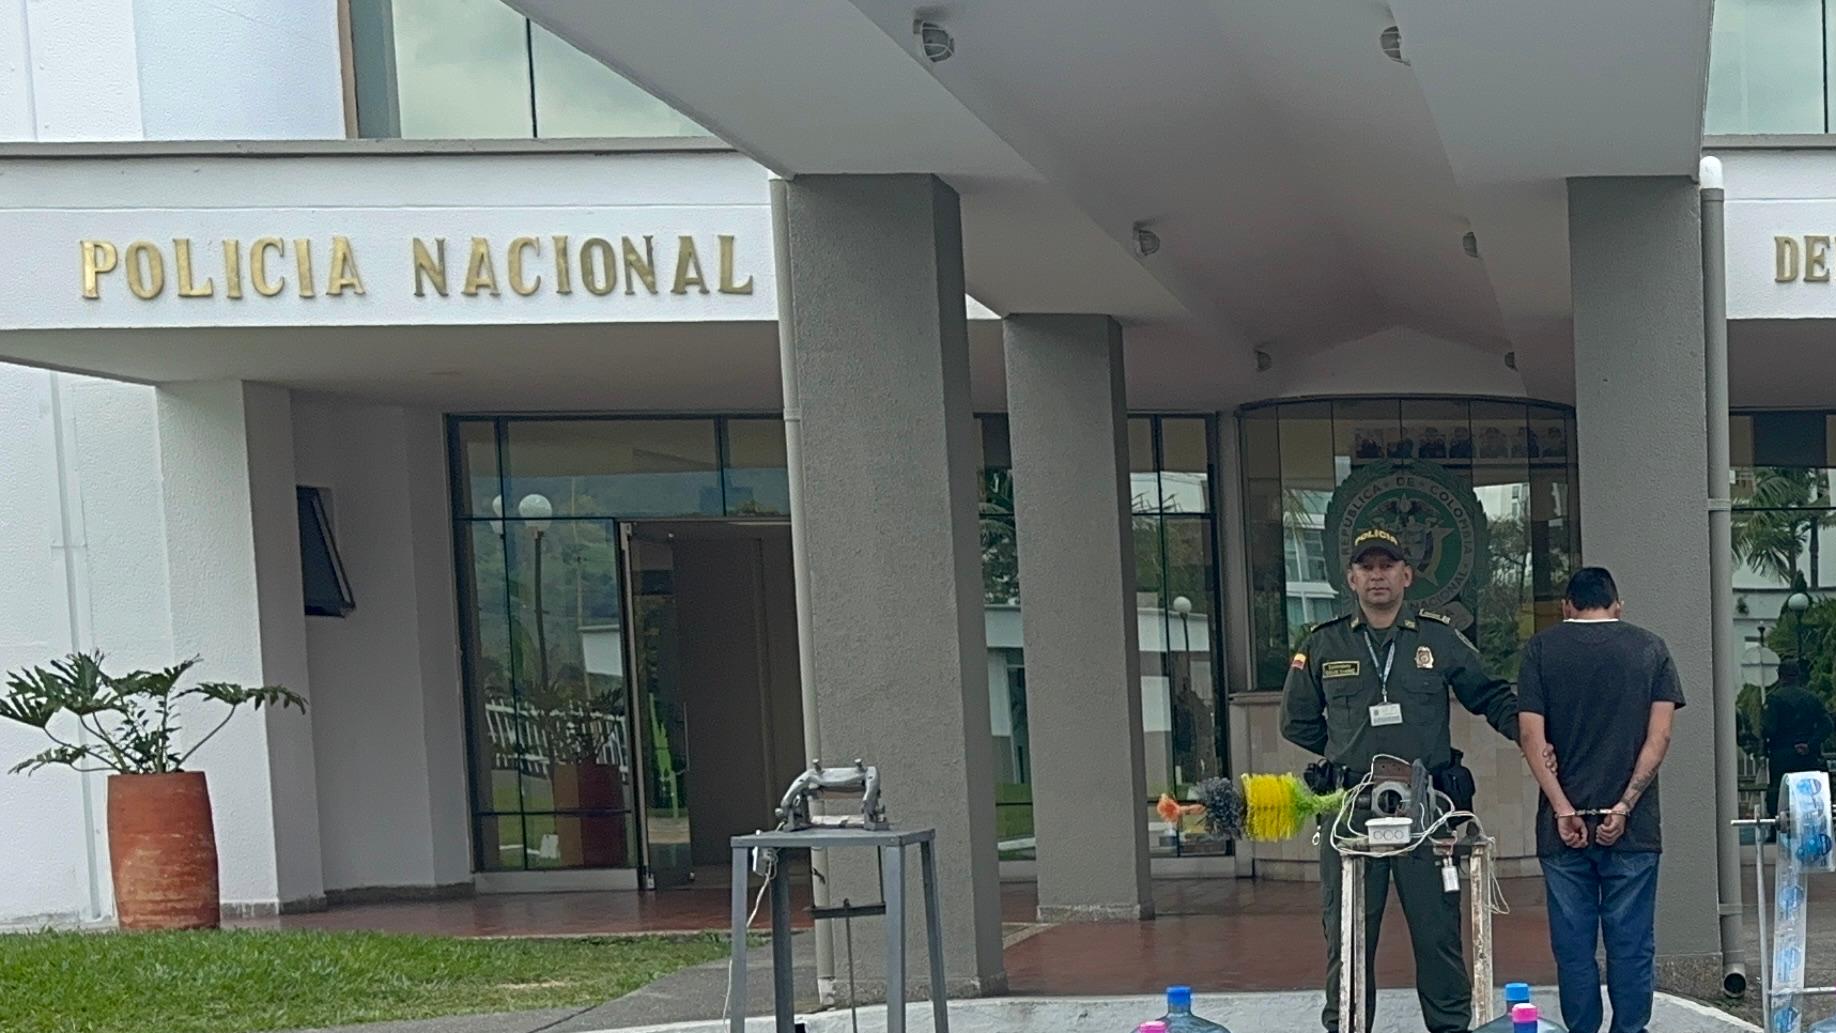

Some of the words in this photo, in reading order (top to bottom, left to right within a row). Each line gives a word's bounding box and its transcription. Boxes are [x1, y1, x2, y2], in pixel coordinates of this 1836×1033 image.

[79, 236, 366, 300] POLICIA
[412, 234, 754, 297] NACIONAL
[1355, 529, 1398, 546] POLICIA
[1396, 476, 1415, 486] DE
[1431, 484, 1473, 554] COLOMBIA
